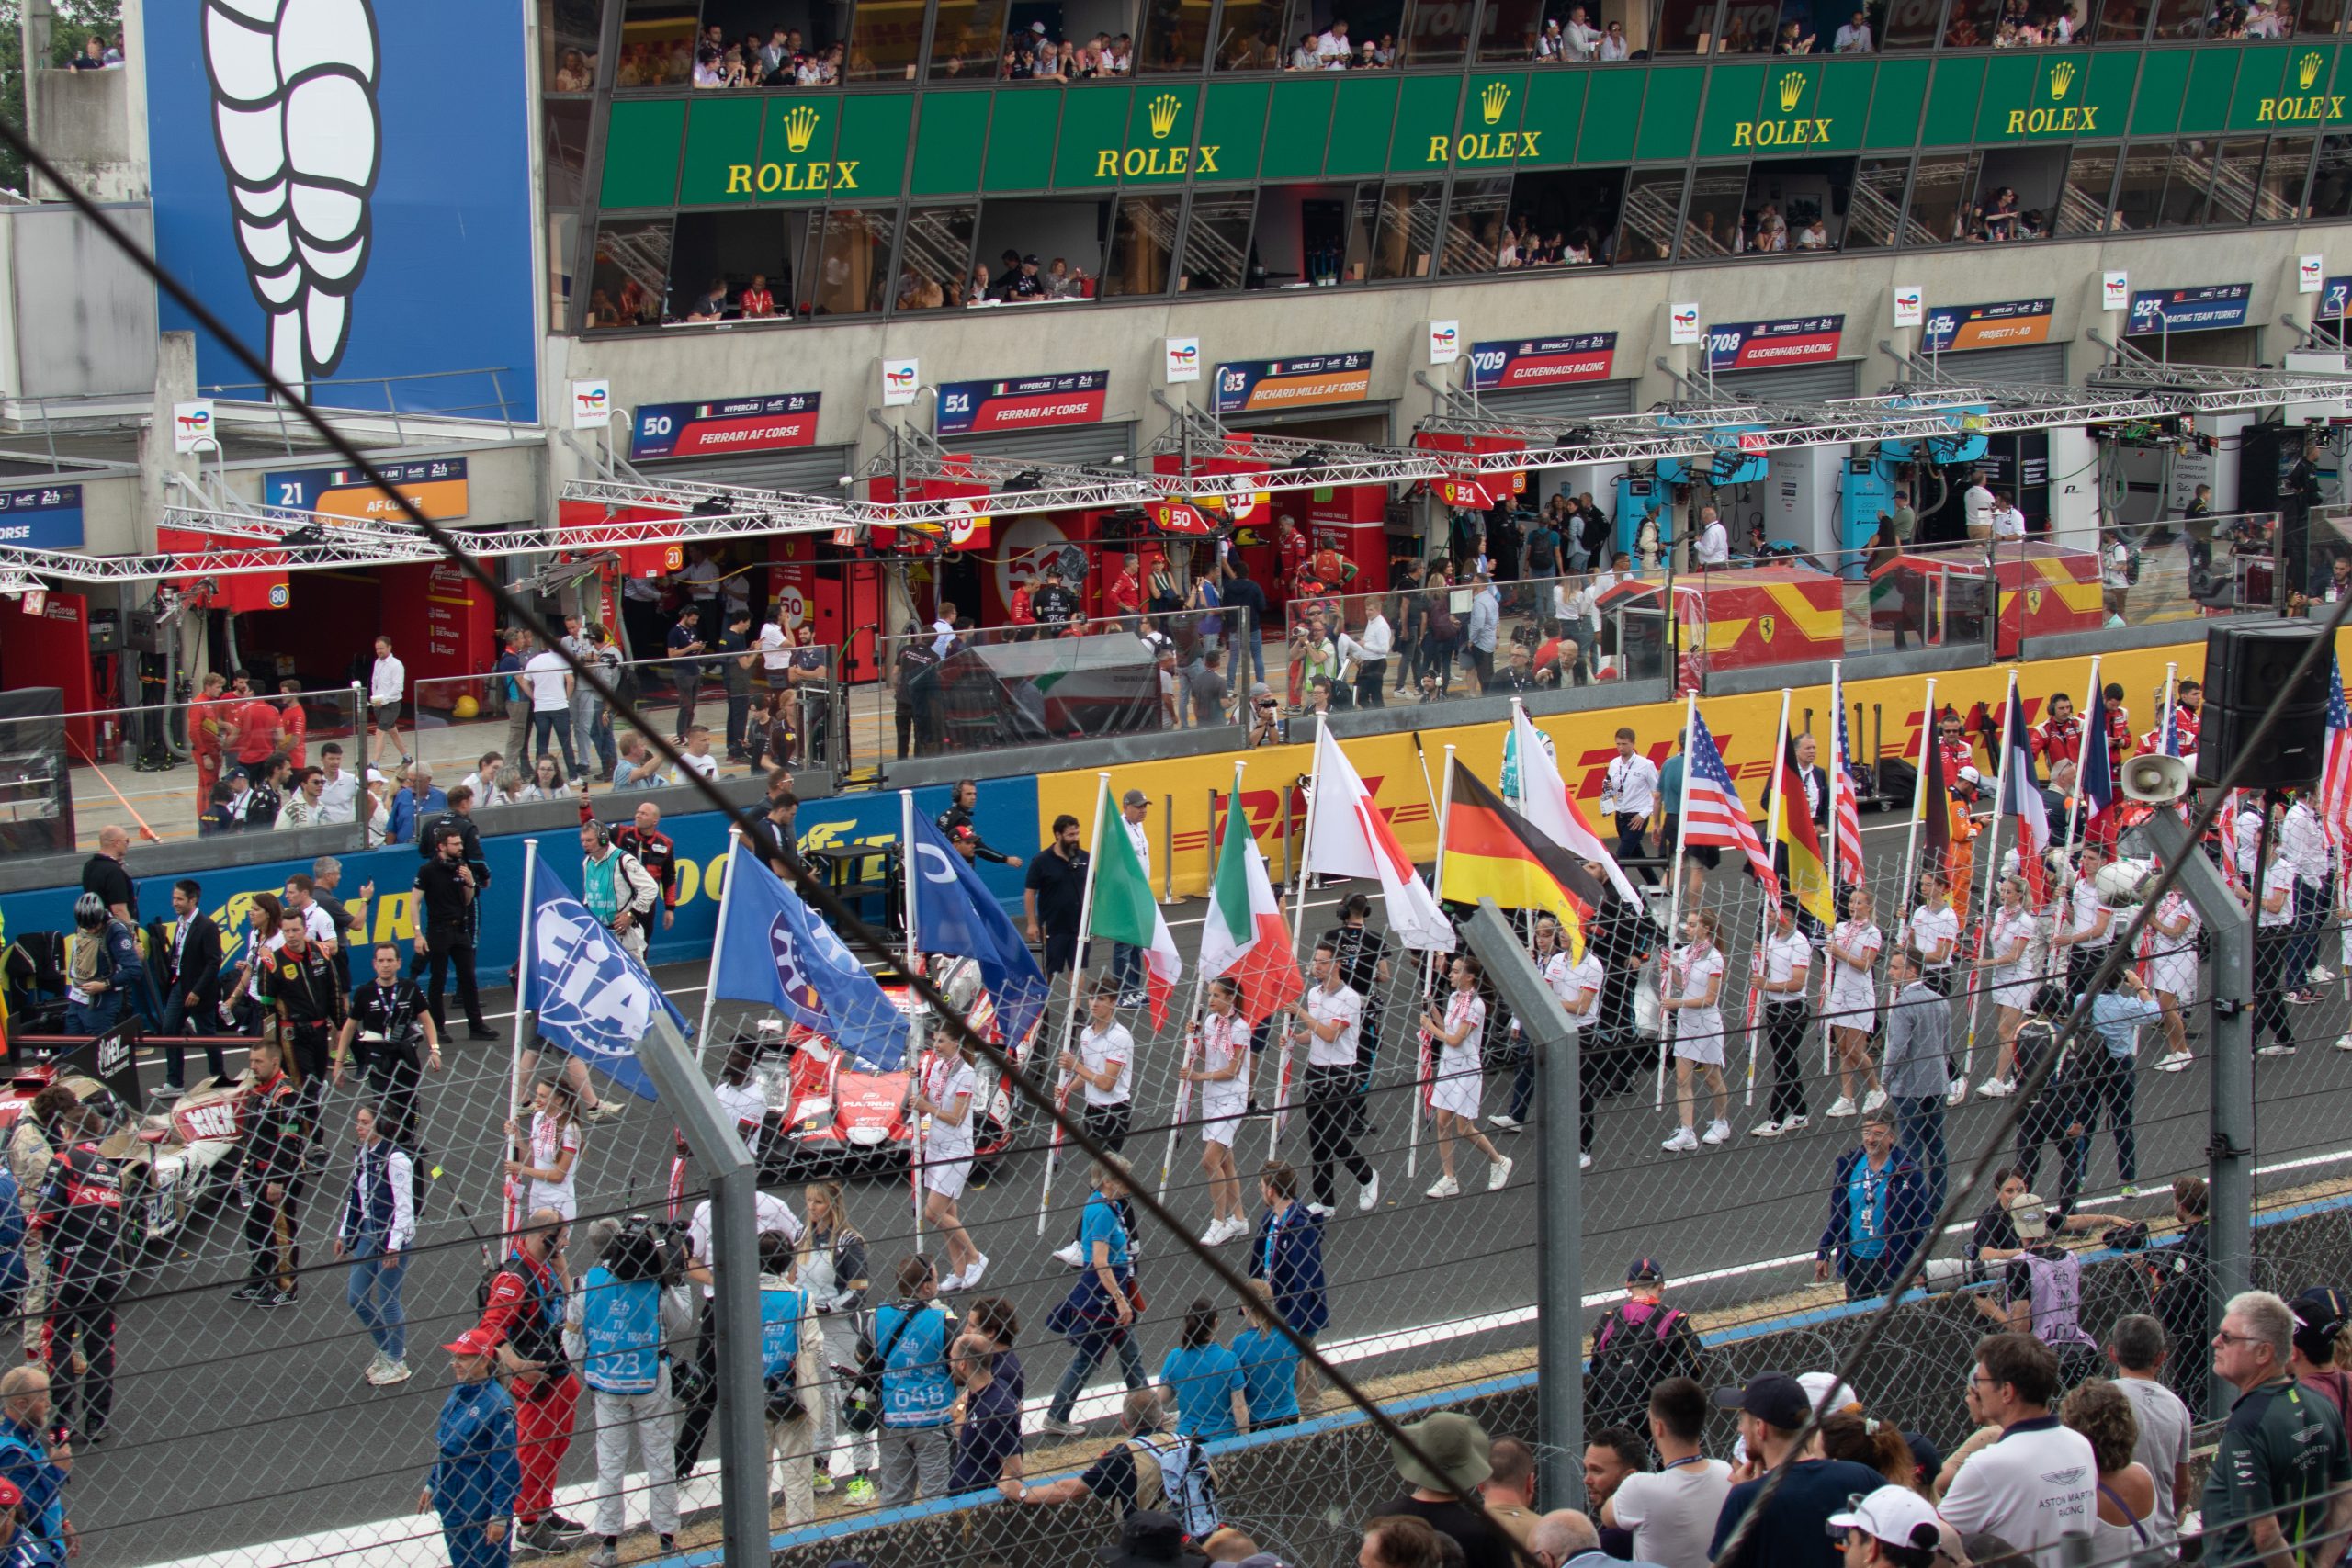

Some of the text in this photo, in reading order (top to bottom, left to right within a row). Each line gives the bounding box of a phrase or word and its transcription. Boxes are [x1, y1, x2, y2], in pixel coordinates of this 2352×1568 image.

[2258, 96, 2345, 120] ROLEX
[2007, 107, 2098, 132] ROLEX
[1734, 119, 1831, 146] ROLEX
[1428, 132, 1541, 161] ROLEX
[1096, 146, 1219, 176] ROLEX
[728, 162, 858, 192] ROLEX
[2166, 309, 2242, 323] RACING TEAM TURKEY
[1773, 322, 1799, 333] HYPERCAR
[1978, 327, 2008, 339] PROJECT
[1541, 342, 1568, 352] HYPERCAR
[1711, 333, 1740, 351] 708
[1747, 343, 1832, 359] GLICKENHAUS RACING
[1291, 362, 1309, 371] LMGTE
[1309, 361, 1319, 369] AM
[1474, 351, 1506, 371] 709
[1513, 361, 1603, 378] GLICKENHAUS RACING
[1019, 380, 1051, 391] HYPERCAR
[1224, 373, 1245, 392] 83
[1253, 380, 1367, 400] RICHARD MILLE AF CORSE
[724, 401, 759, 414] HYPERCAR
[944, 394, 970, 412] 51
[996, 402, 1089, 422] FERRARI AF CORSE
[643, 416, 672, 436] 50
[699, 424, 799, 446] FERRARI AF CORSE
[386, 470, 399, 479] AM
[1513, 479, 1523, 488] 83
[280, 482, 302, 505] 21
[1457, 486, 1475, 502] 51
[368, 497, 423, 513] AF COSE
[1173, 510, 1191, 527] 50
[837, 528, 853, 543] 21
[667, 552, 679, 565] 21
[26, 592, 42, 612] 54
[271, 590, 285, 603] 80
[906, 650, 932, 661] CADILLAC
[907, 655, 927, 664] RACING
[788, 1125, 831, 1140] Sonangol
[613, 1319, 625, 1330] TV
[628, 1331, 654, 1342] TRACK
[596, 1350, 640, 1376] 523
[895, 1383, 944, 1407] 648
[2039, 1495, 2066, 1509] ASTON
[2058, 1505, 2085, 1517] RACING
